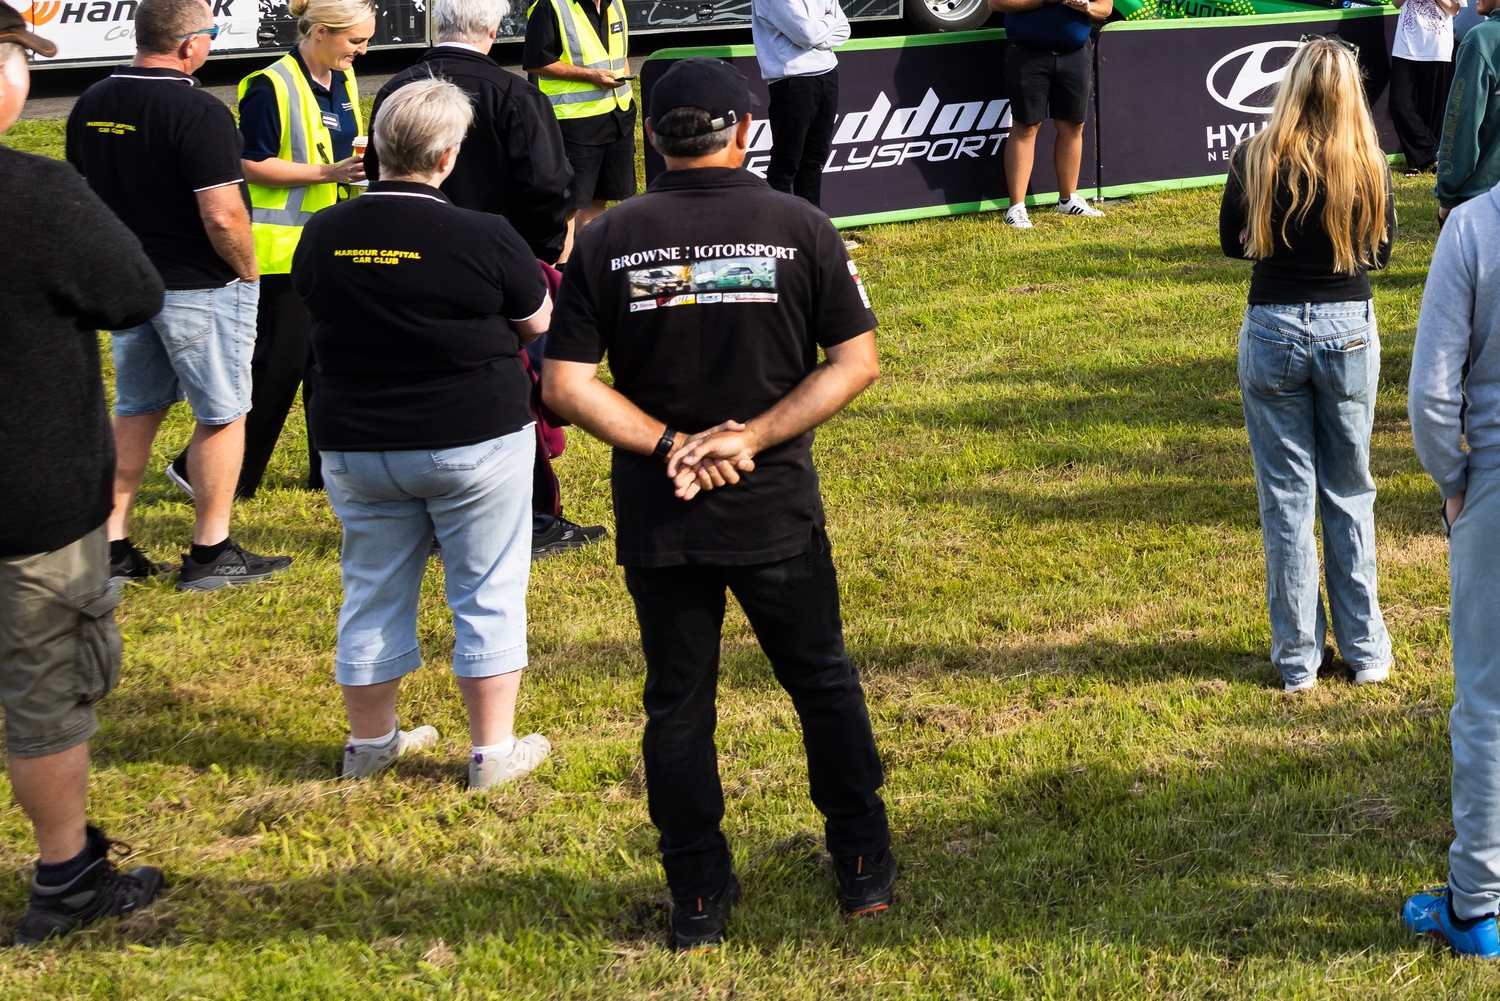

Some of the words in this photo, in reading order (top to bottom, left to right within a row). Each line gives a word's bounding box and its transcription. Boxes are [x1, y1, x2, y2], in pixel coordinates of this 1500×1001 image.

[746, 132, 1011, 179] RLYSPORT
[1208, 151, 1230, 161] NE
[380, 250, 421, 259] CAPITAL
[611, 246, 681, 271] BROWNE
